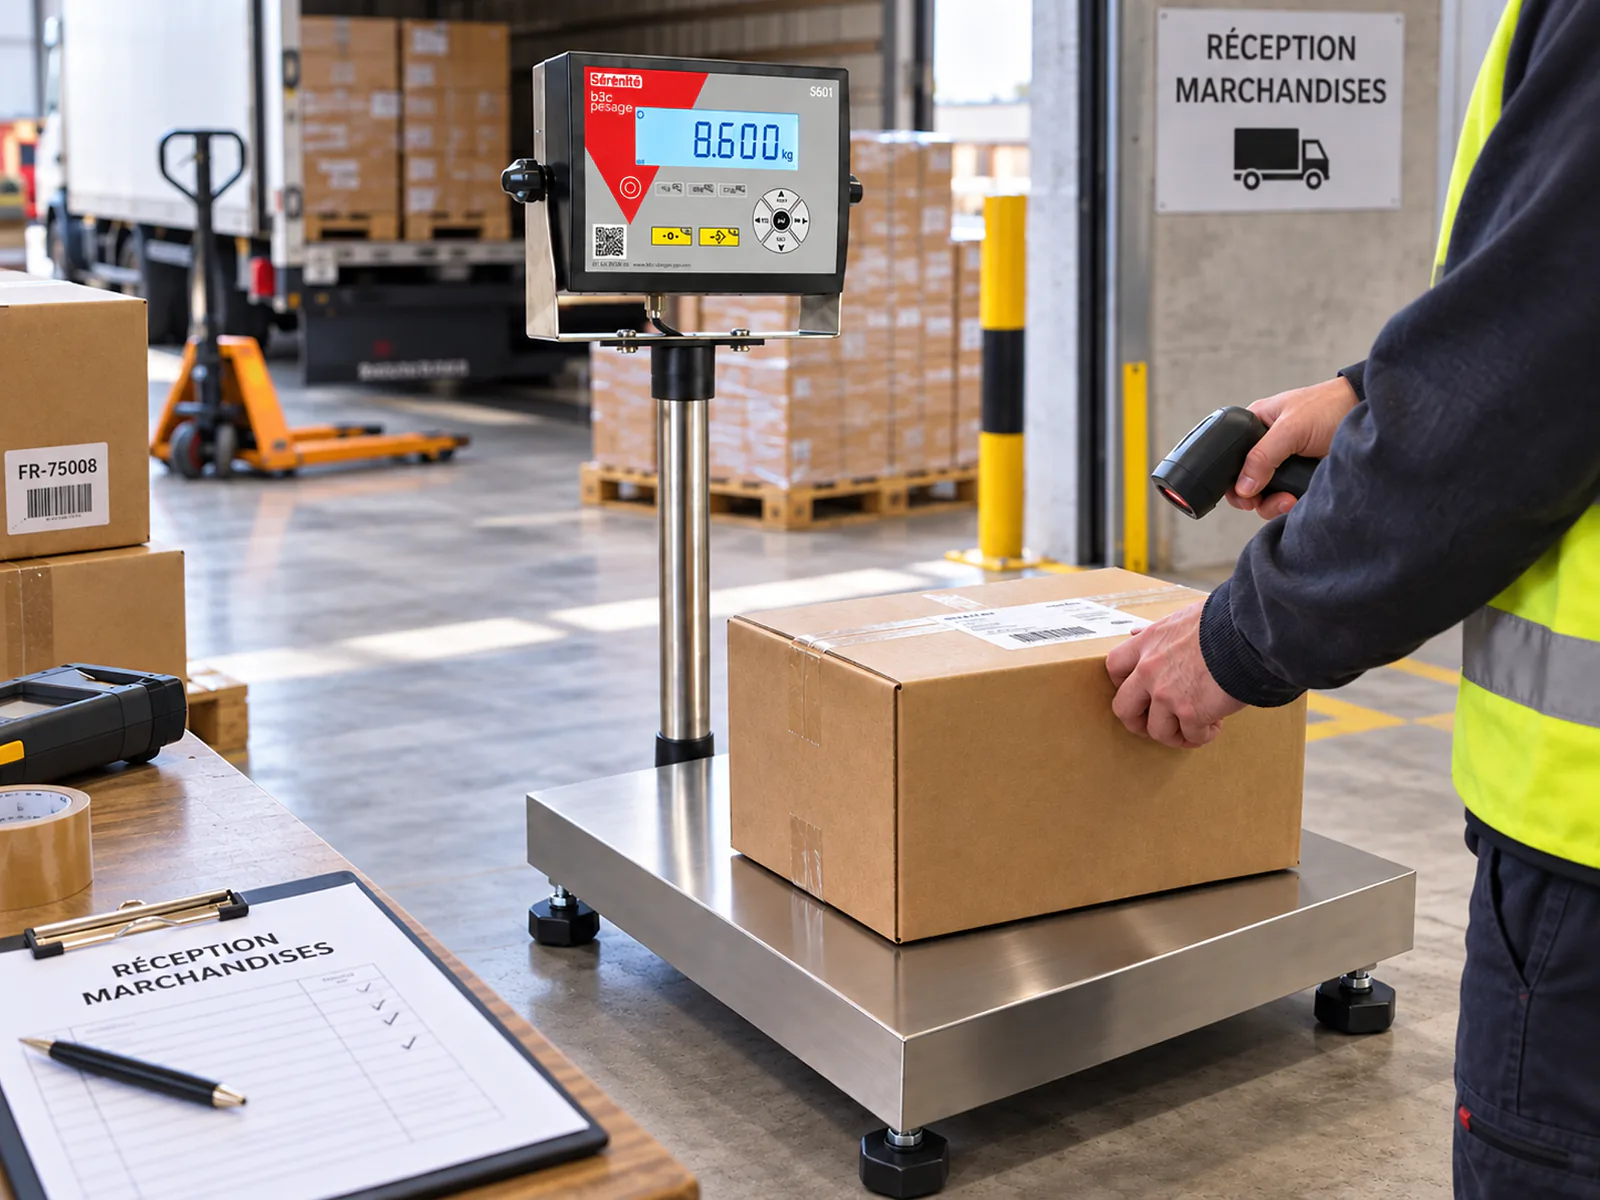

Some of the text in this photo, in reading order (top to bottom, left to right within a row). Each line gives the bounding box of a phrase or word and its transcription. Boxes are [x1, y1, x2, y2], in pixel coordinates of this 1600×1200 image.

[1207, 27, 1356, 61] RÉCEPTION
[590, 90, 613, 103] b3c
[810, 86, 833, 98] S601
[1176, 77, 1387, 104] MARCHANDISES
[590, 102, 633, 116] pesage
[694, 121, 793, 162] 8.600 kg
[18, 458, 97, 480] FR-75008
[111, 932, 280, 978] RÉCEPTION
[82, 941, 335, 1006] MARCHANDISES
